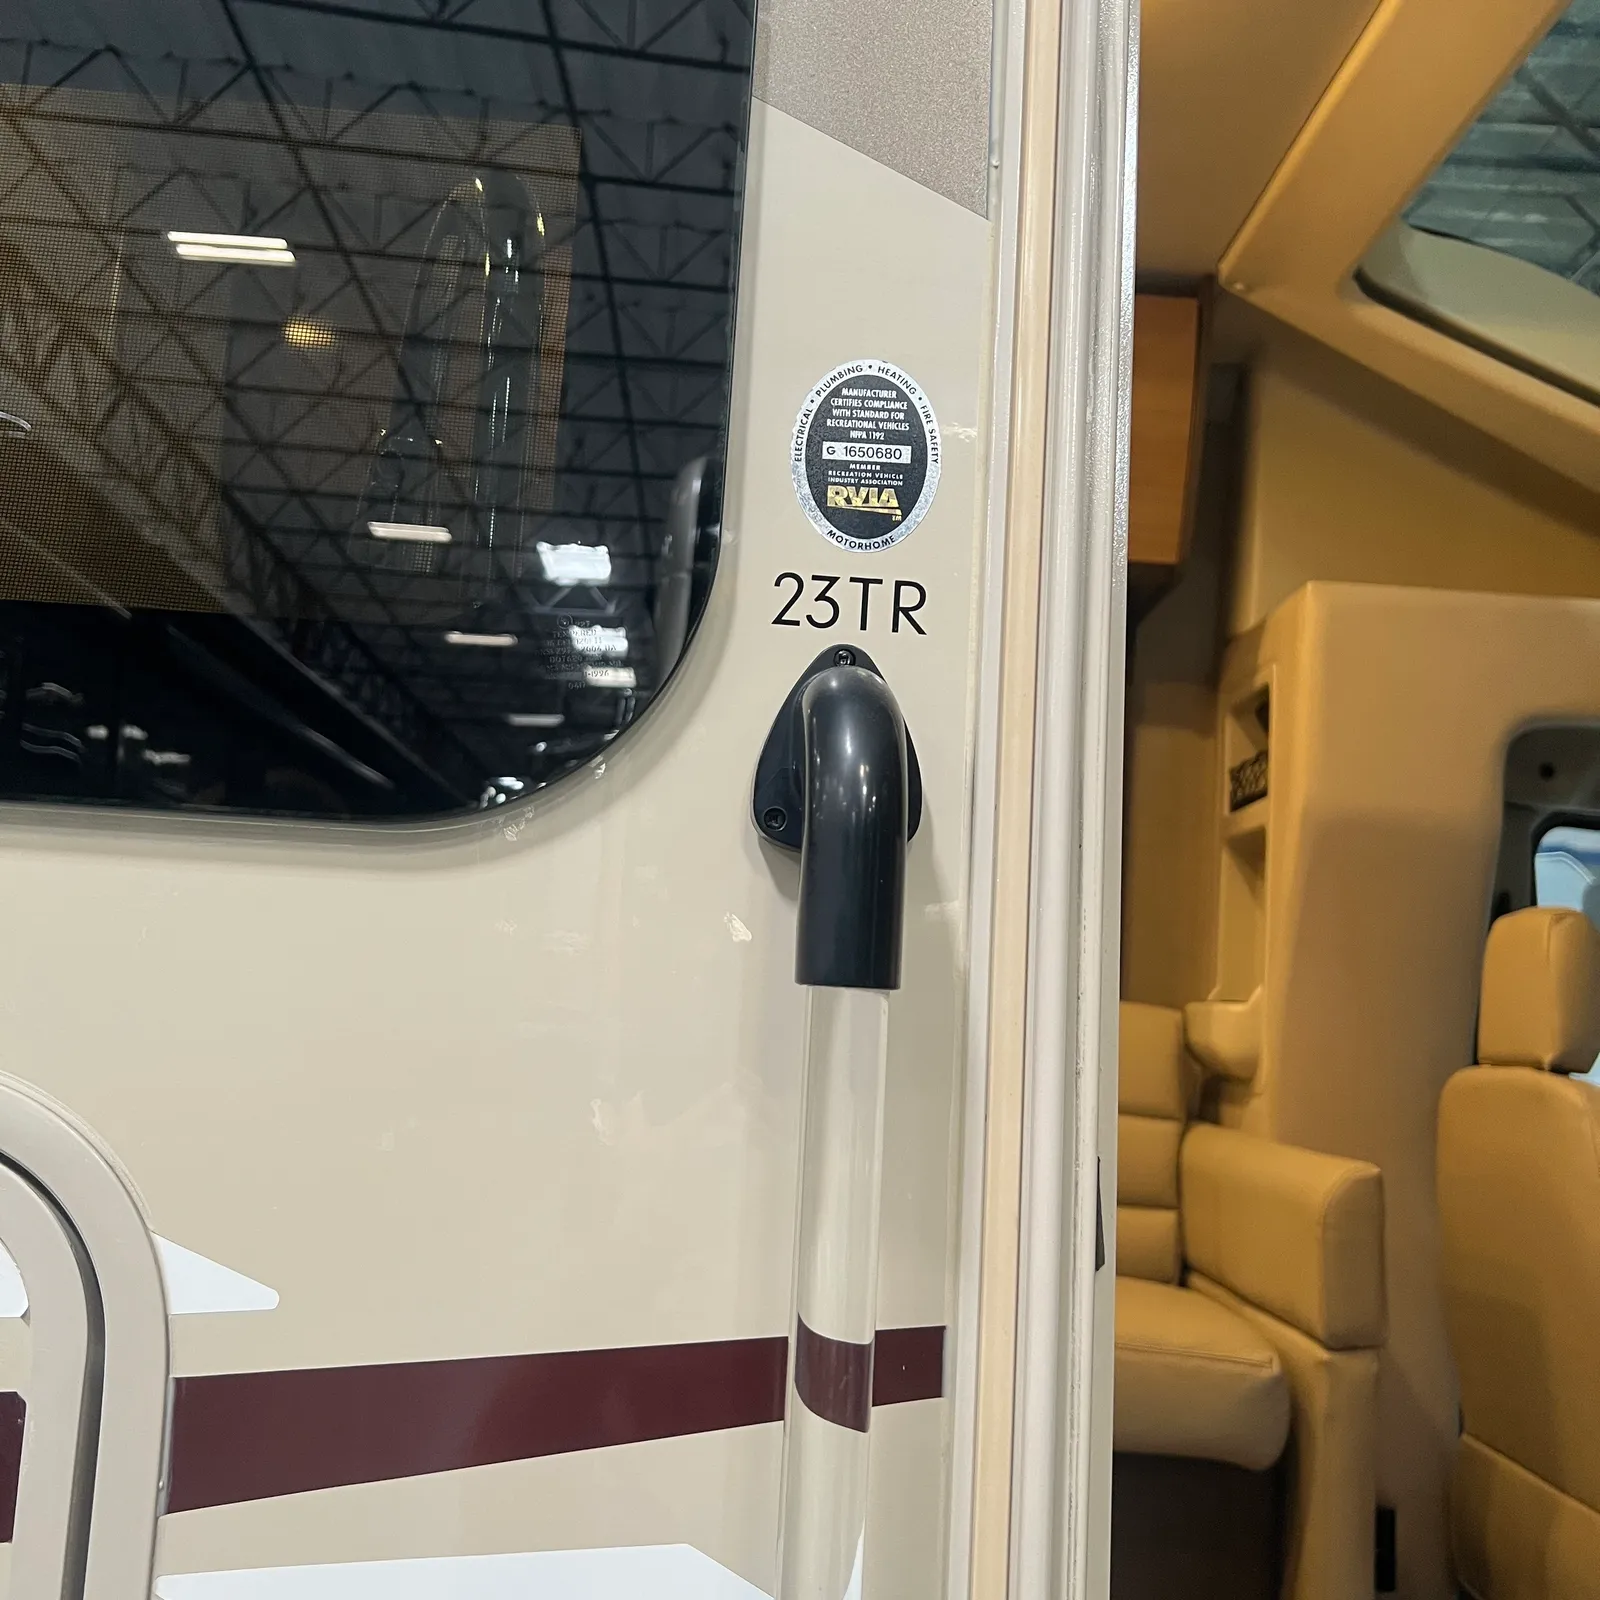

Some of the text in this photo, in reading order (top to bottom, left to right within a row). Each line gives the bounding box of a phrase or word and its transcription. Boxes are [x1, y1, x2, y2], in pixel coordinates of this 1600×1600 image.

[816, 365, 863, 397] PLUMBING
[878, 366, 917, 395] HEATING
[842, 388, 897, 398] MANUFACTURER
[830, 398, 908, 409] CERTIFIES COMPLIANCE
[832, 409, 904, 420] WITH STANDARD FOR
[826, 420, 909, 430] RECREATIONAL VEHICLES
[794, 408, 814, 461] ELECTRICAL
[850, 431, 884, 440] NFPA 1192
[920, 405, 939, 464] FIRE SAFETY
[826, 446, 902, 460] G 1650680
[828, 470, 904, 480] RECREATION VEHICLE
[860, 478, 903, 486] ASSOCIATION
[827, 485, 900, 508] RVIA
[826, 530, 896, 550] MOTORHOME
[771, 571, 927, 635] 23TR
